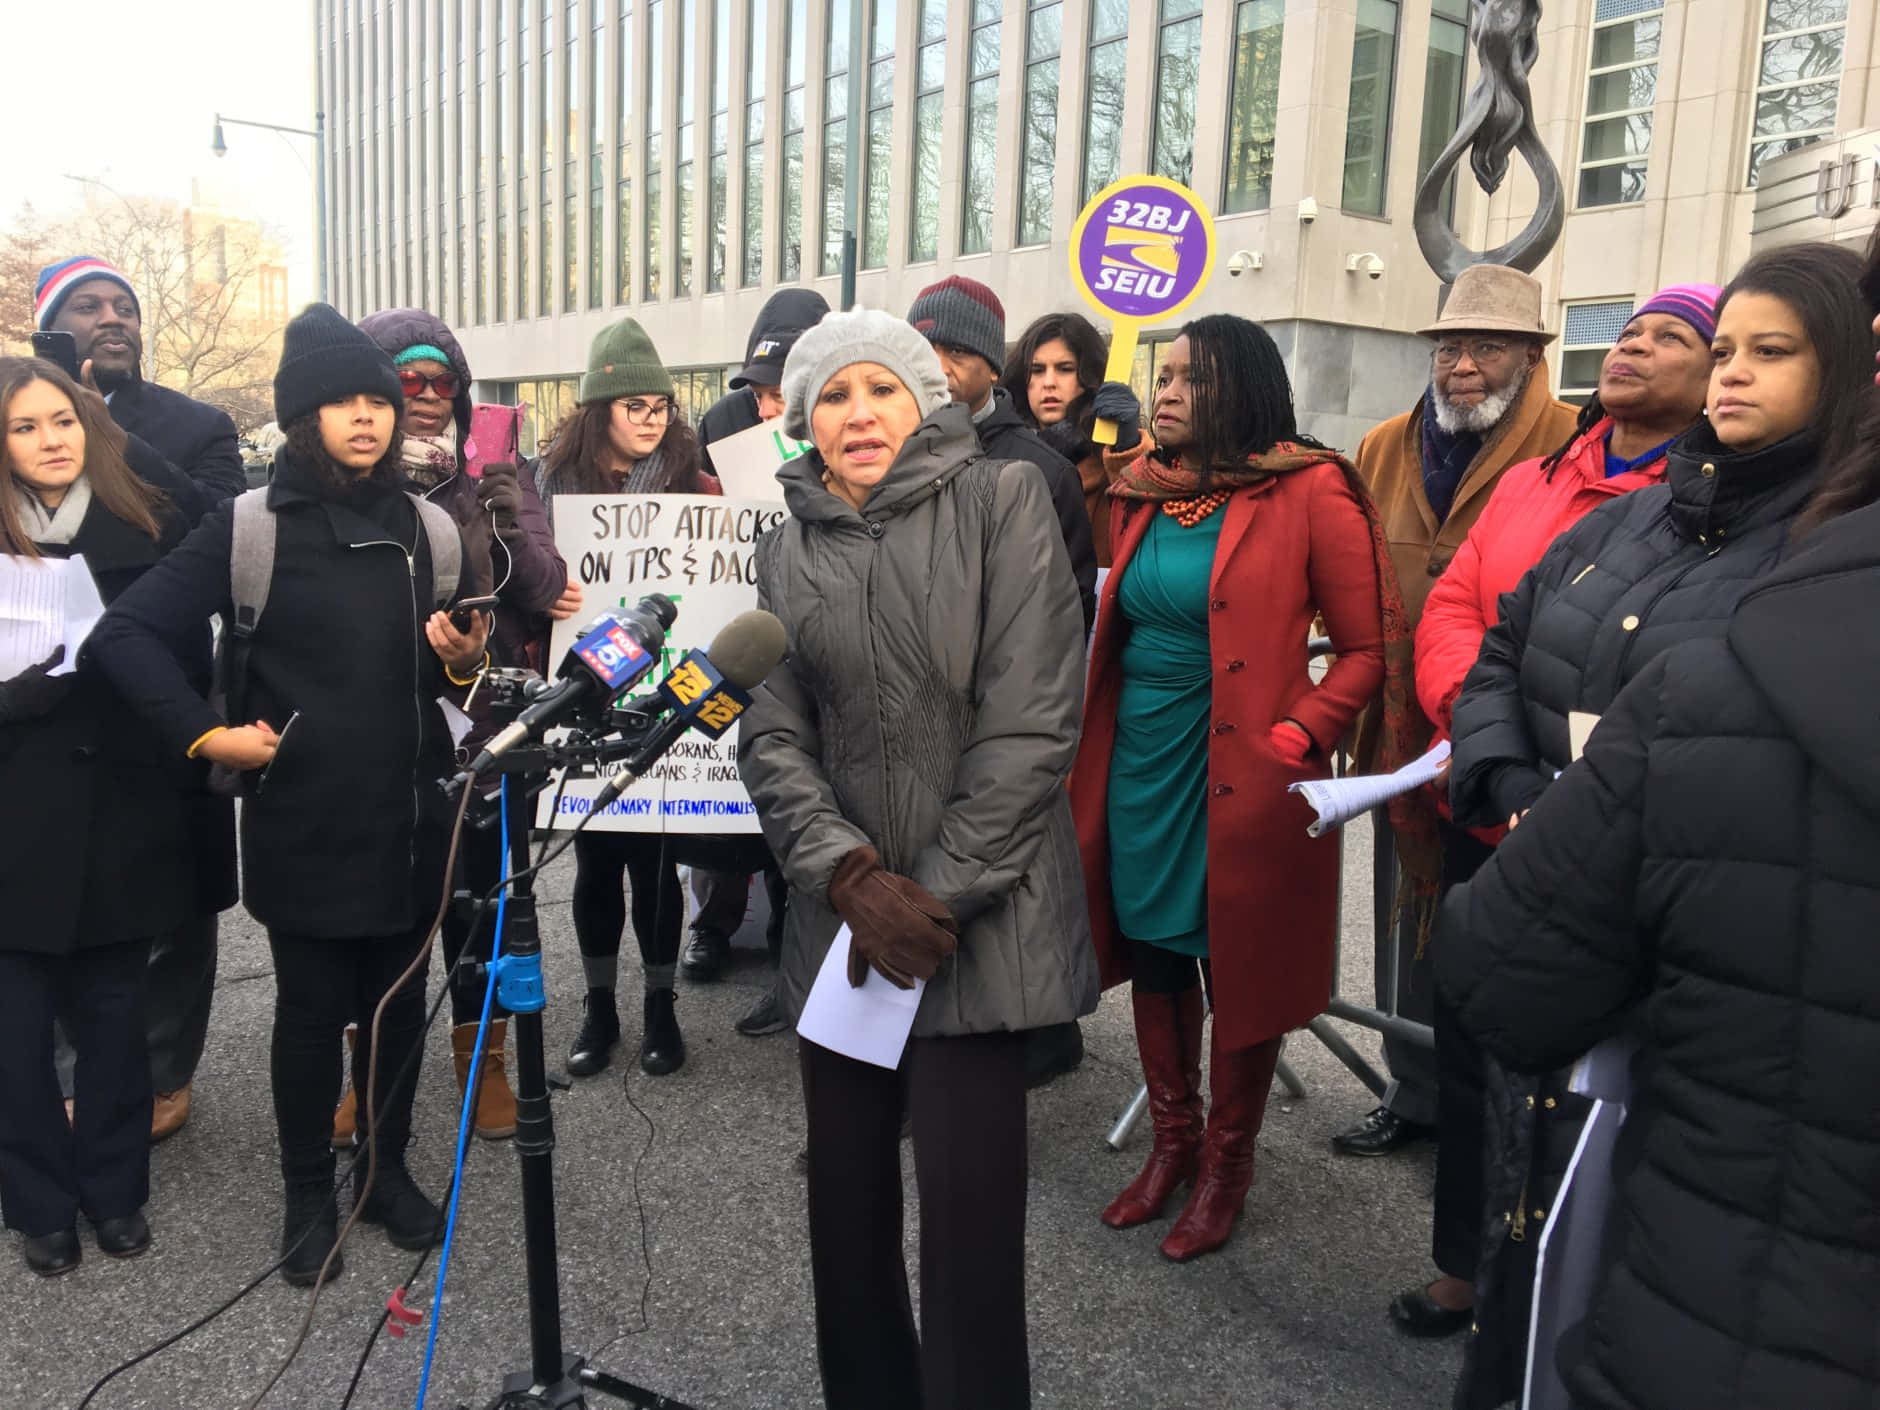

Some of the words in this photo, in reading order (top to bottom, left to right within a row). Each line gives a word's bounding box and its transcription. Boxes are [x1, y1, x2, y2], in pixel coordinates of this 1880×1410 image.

[1107, 199, 1191, 233] 32BJ
[1094, 268, 1177, 299] SEIU
[592, 501, 661, 540] STOP
[674, 504, 785, 544] ATTACKS
[580, 551, 613, 585] ON
[625, 547, 672, 584] TPS
[682, 542, 701, 585] &
[710, 550, 757, 586] DAC
[597, 643, 627, 667] 5
[612, 630, 639, 657] FOX
[667, 667, 703, 706] 12
[696, 700, 734, 730] 12
[665, 742, 722, 762] DORANS,
[707, 765, 741, 782] IRAQ
[554, 795, 652, 816] EVOLIONARY
[658, 799, 757, 817] INTERNATIONALIS
